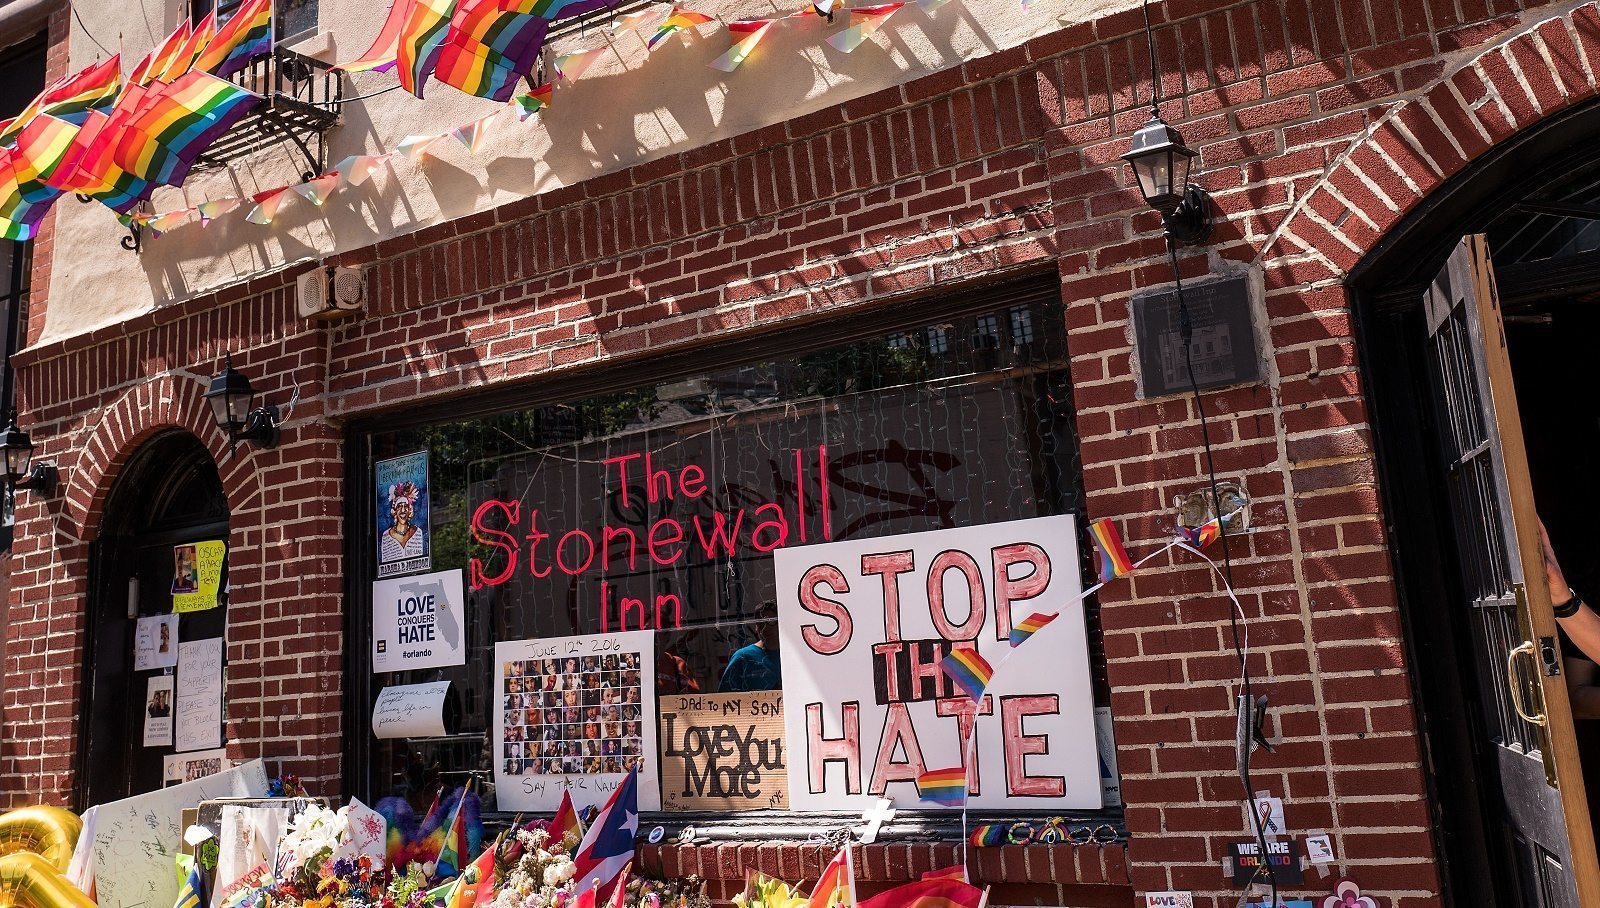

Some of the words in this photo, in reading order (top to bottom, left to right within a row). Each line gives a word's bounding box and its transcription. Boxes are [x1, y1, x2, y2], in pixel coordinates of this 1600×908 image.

[603, 452, 707, 509] The
[468, 444, 831, 590] Stonewall
[398, 595, 435, 616] LOVE
[600, 580, 682, 633] Inn
[797, 542, 1051, 655] STOP
[397, 614, 435, 626] CONQUERS
[399, 623, 435, 644] HATE
[402, 649, 432, 658] #orlando
[525, 643, 557, 658] JUNE
[591, 639, 620, 652] 2016
[722, 699, 741, 716] MY
[751, 697, 783, 717] SON
[662, 713, 734, 757] Love
[730, 725, 785, 770] You
[805, 694, 1066, 798] HATE
[522, 777, 546, 798] SAY
[682, 755, 761, 799] More
[1237, 843, 1259, 854] WE
[1262, 842, 1289, 853] ARE
[1240, 855, 1290, 866] ORLANDO
[1149, 896, 1175, 906] LOVE
